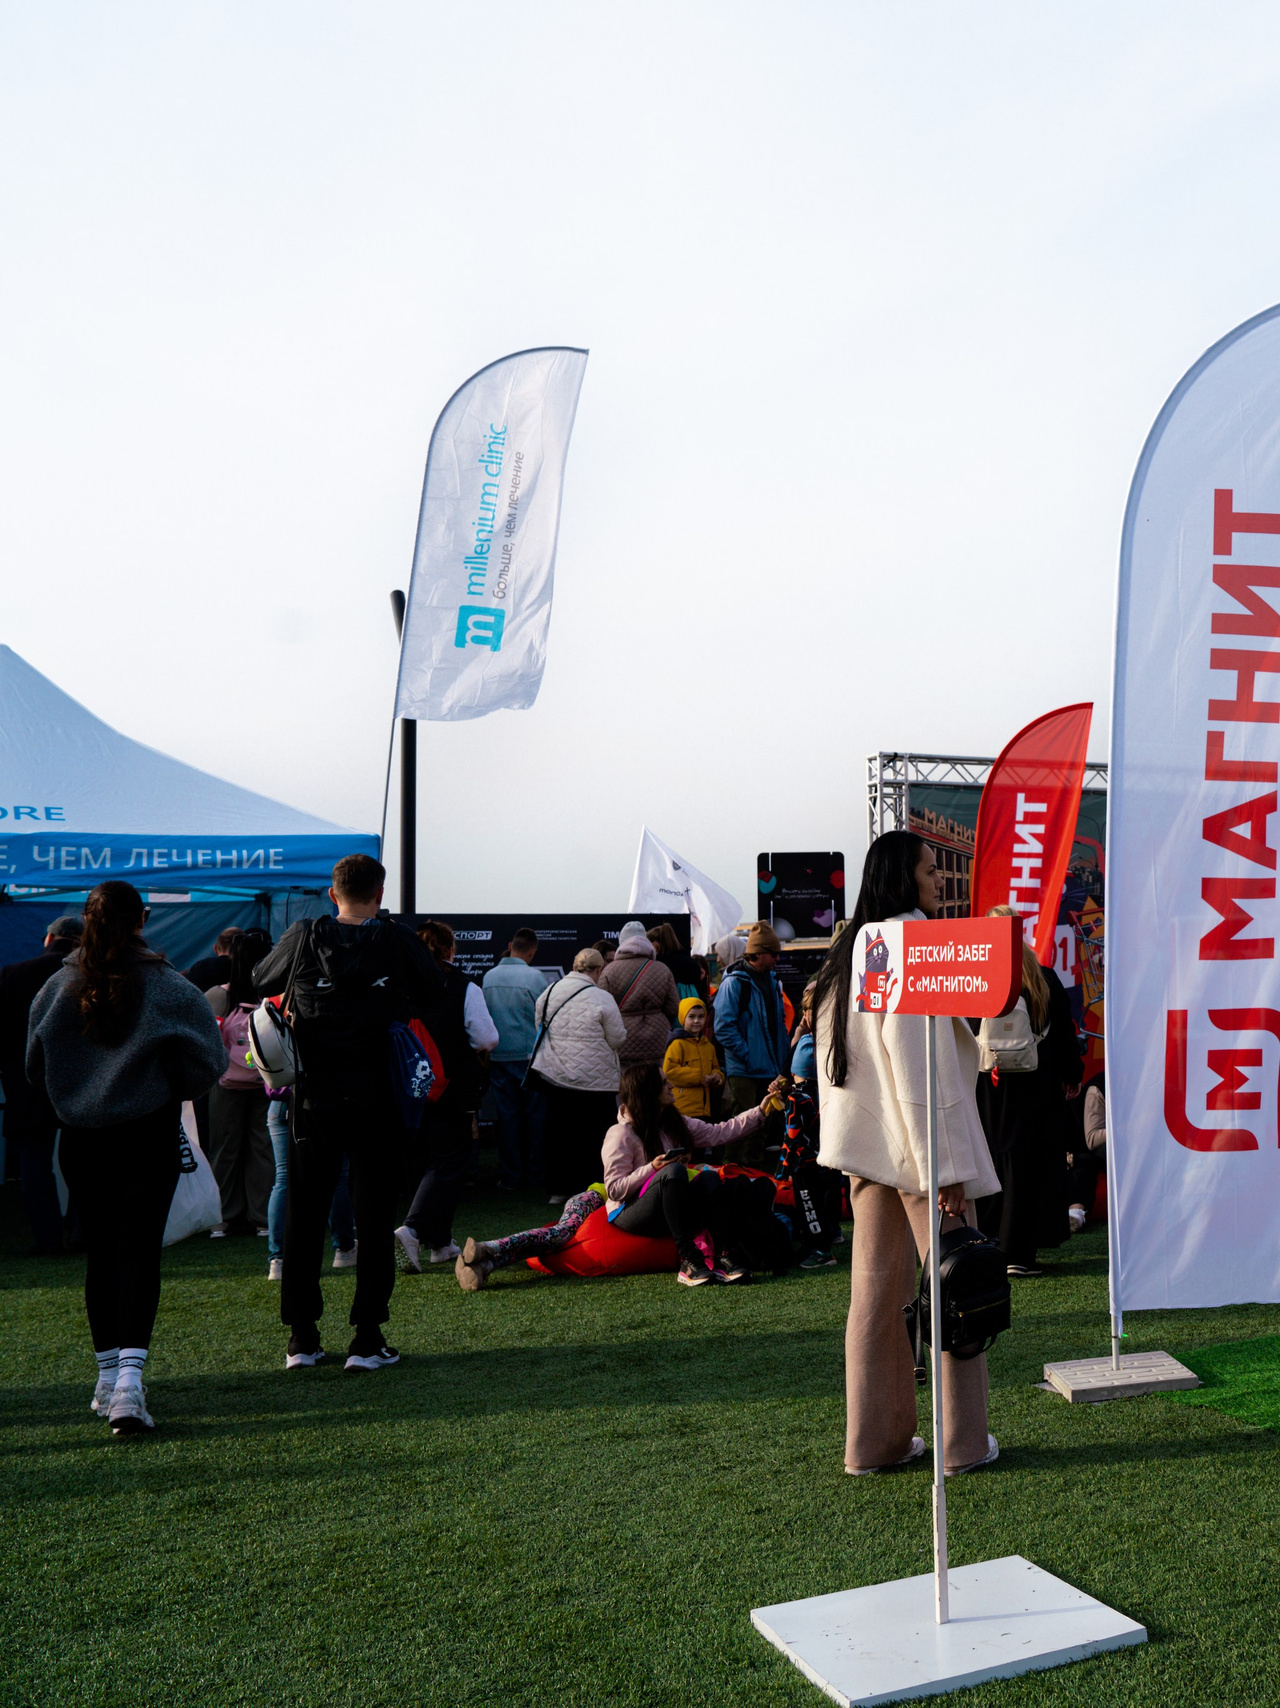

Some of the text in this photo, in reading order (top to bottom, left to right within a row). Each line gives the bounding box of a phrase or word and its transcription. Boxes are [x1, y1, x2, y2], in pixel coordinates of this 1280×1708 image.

[464, 423, 508, 597] millenium clinic
[492, 451, 525, 599] больше, чем лечение
[32, 845, 112, 871] ЧЕМ
[123, 847, 284, 869] ЛЕЧЕНИЕ
[603, 931, 620, 939] TIM
[907, 941, 992, 964] ДЕТСКИЙ ЗАБЕГ
[907, 976, 989, 993] С «МАГНИТОМ»
